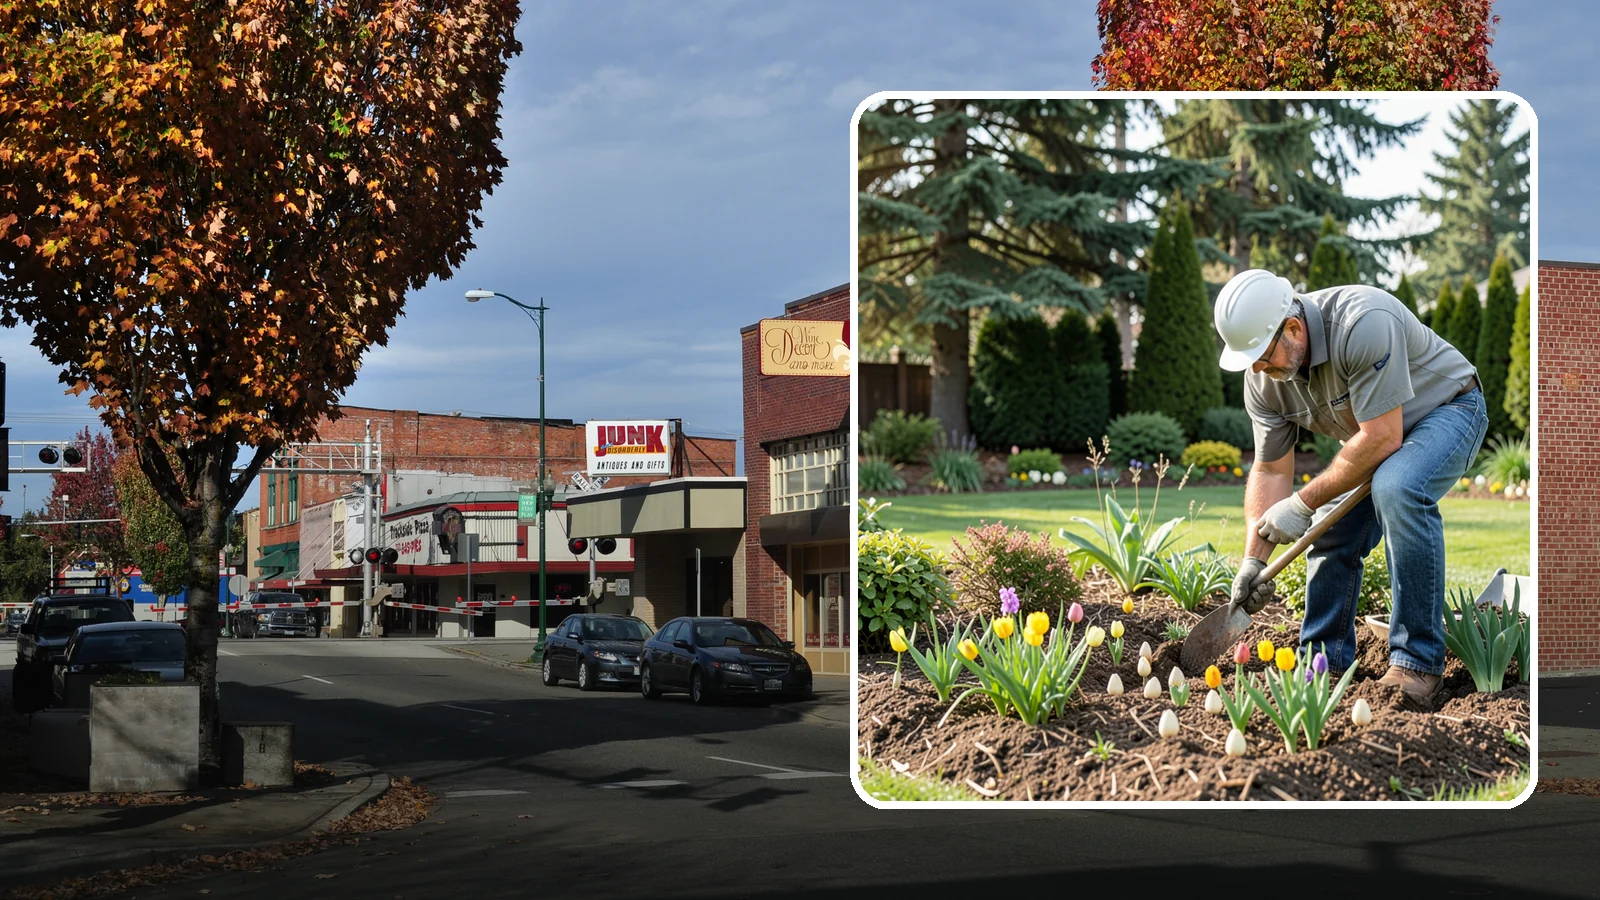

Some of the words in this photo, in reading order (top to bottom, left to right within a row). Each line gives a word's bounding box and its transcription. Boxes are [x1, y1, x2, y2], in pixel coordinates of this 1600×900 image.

[595, 425, 664, 457] JUNK
[607, 446, 646, 454] DISORDERLY
[597, 461, 628, 470] ANTIQUES
[631, 461, 644, 470] AND
[647, 460, 665, 469] GIFTS
[573, 473, 588, 490] RAIL
[414, 519, 429, 534] Pizza
